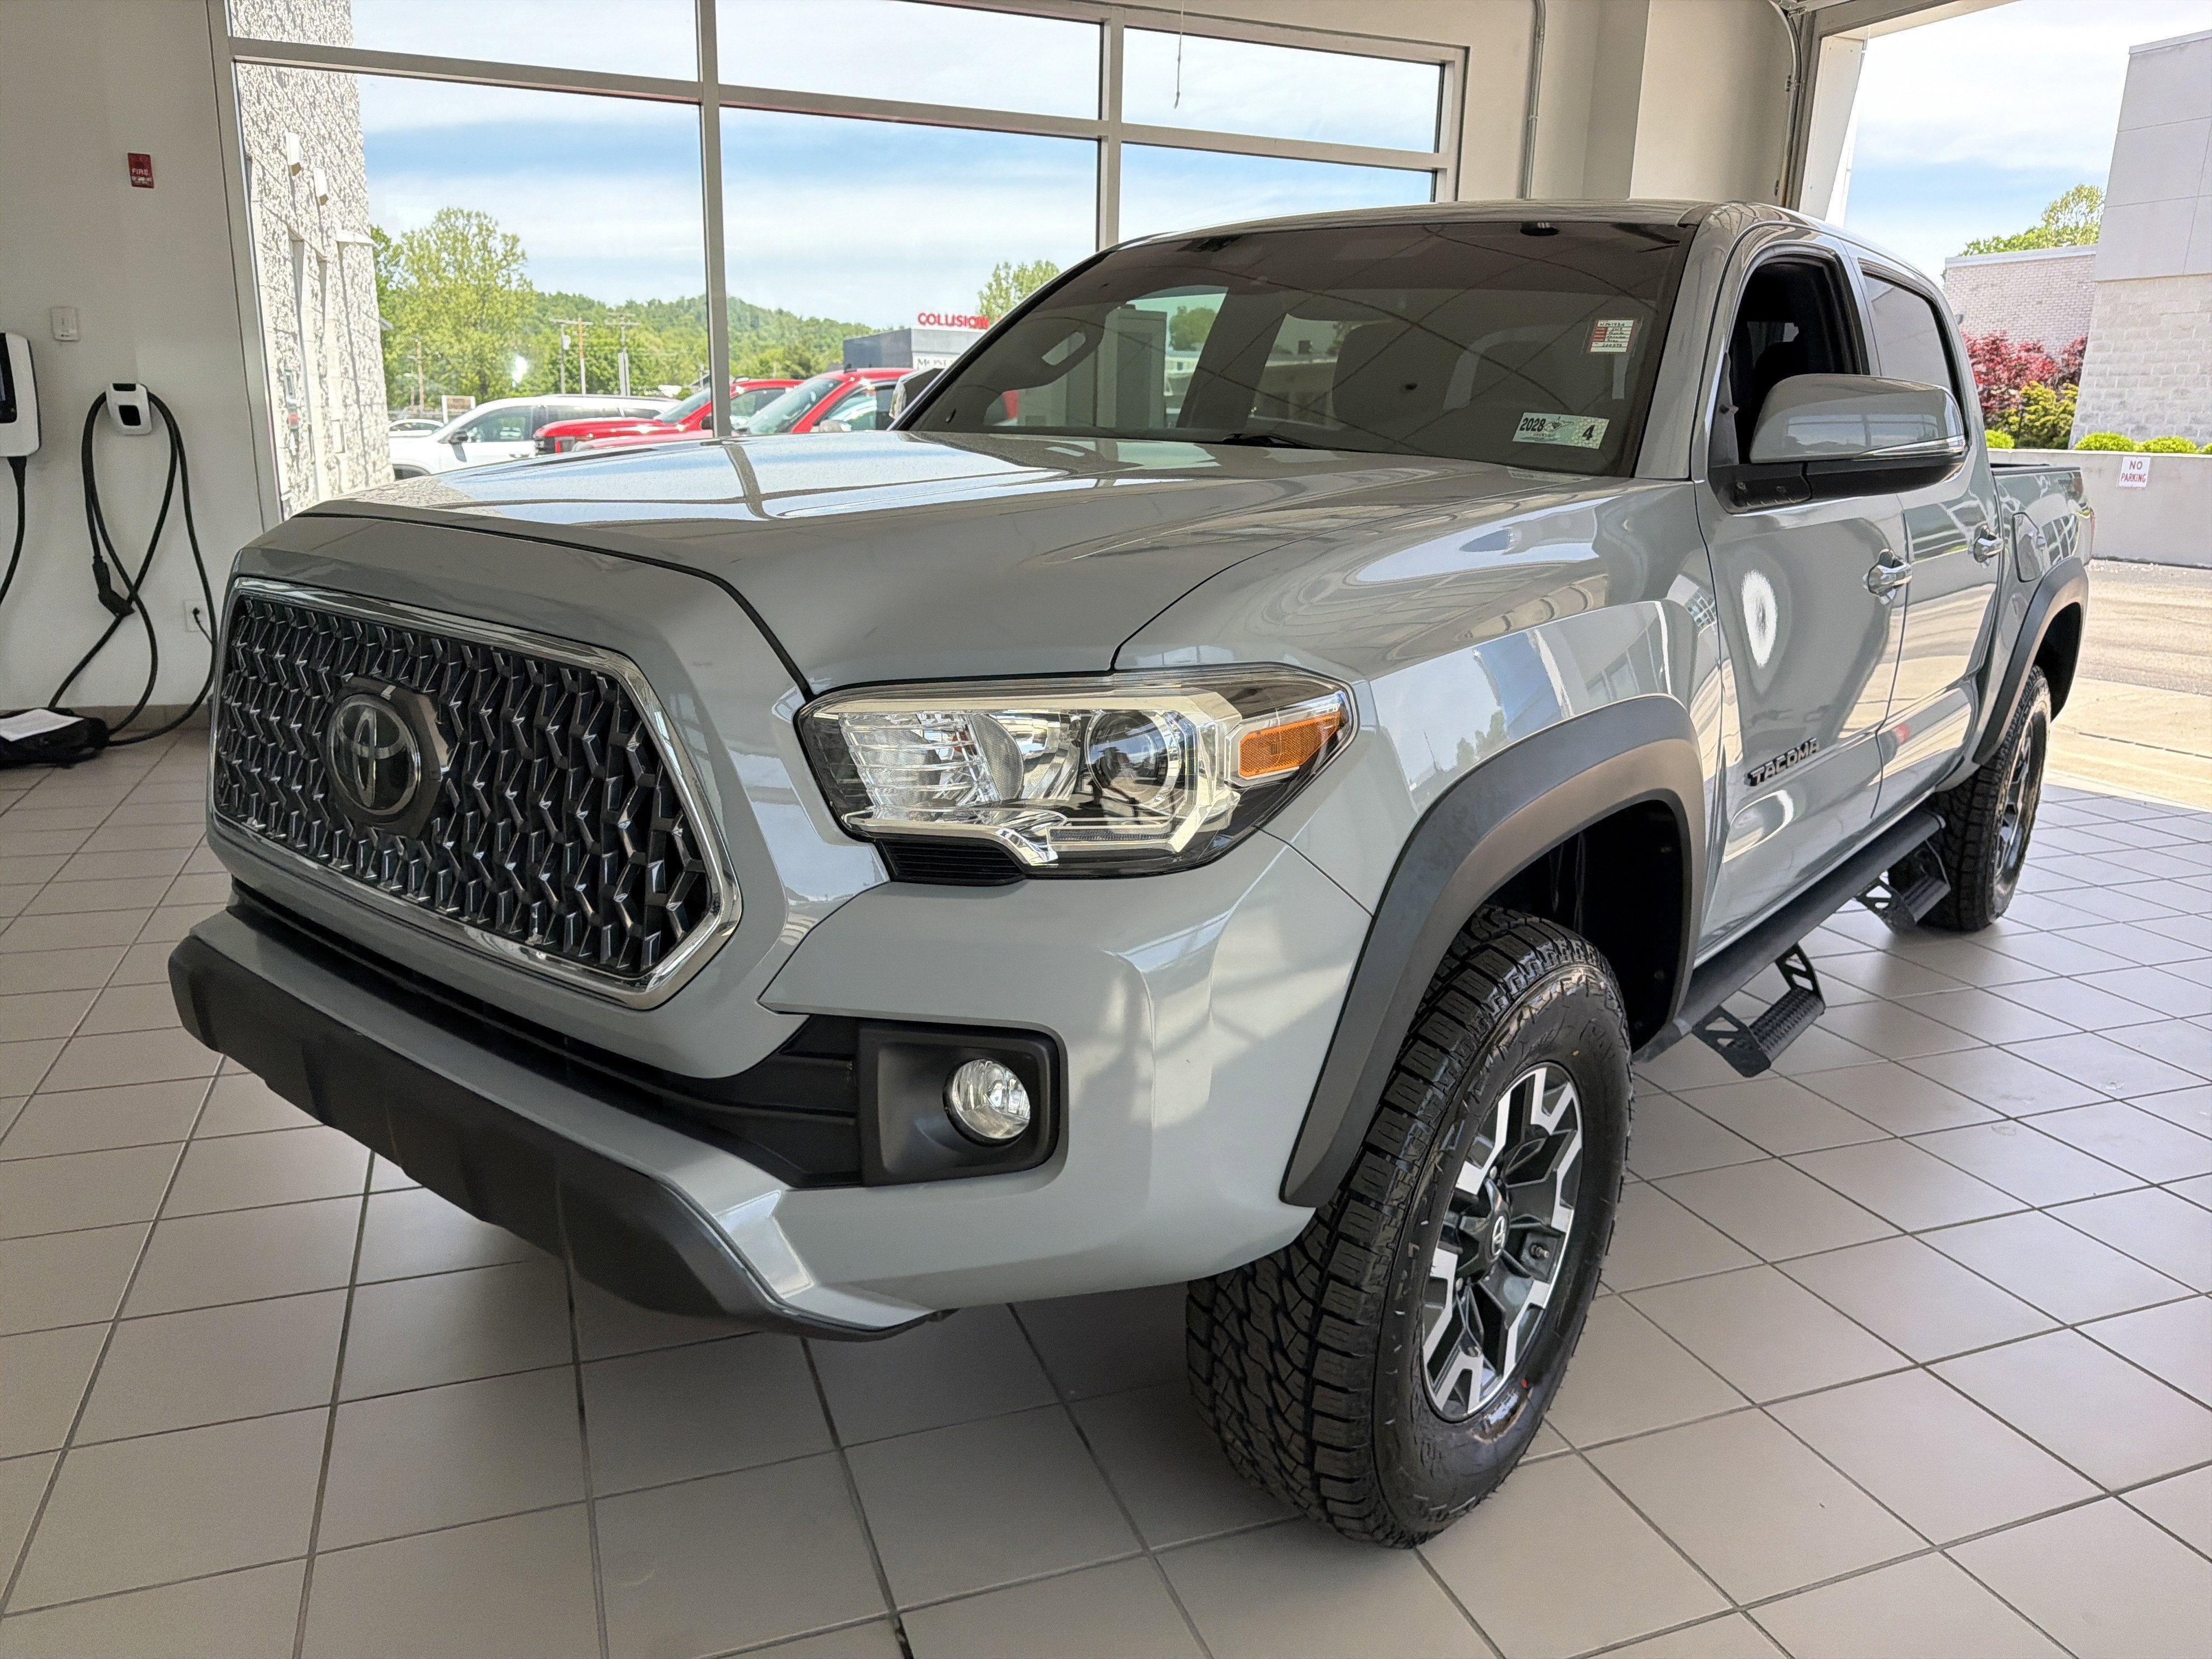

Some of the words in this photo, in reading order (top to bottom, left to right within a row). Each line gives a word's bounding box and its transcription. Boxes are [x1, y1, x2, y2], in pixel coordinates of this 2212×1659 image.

[1519, 417, 1547, 432] 2028
[1581, 424, 1595, 441] 4
[2129, 460, 2143, 470] NO
[2120, 472, 2147, 483] PARKING
[1747, 737, 1820, 787] TACOMA
